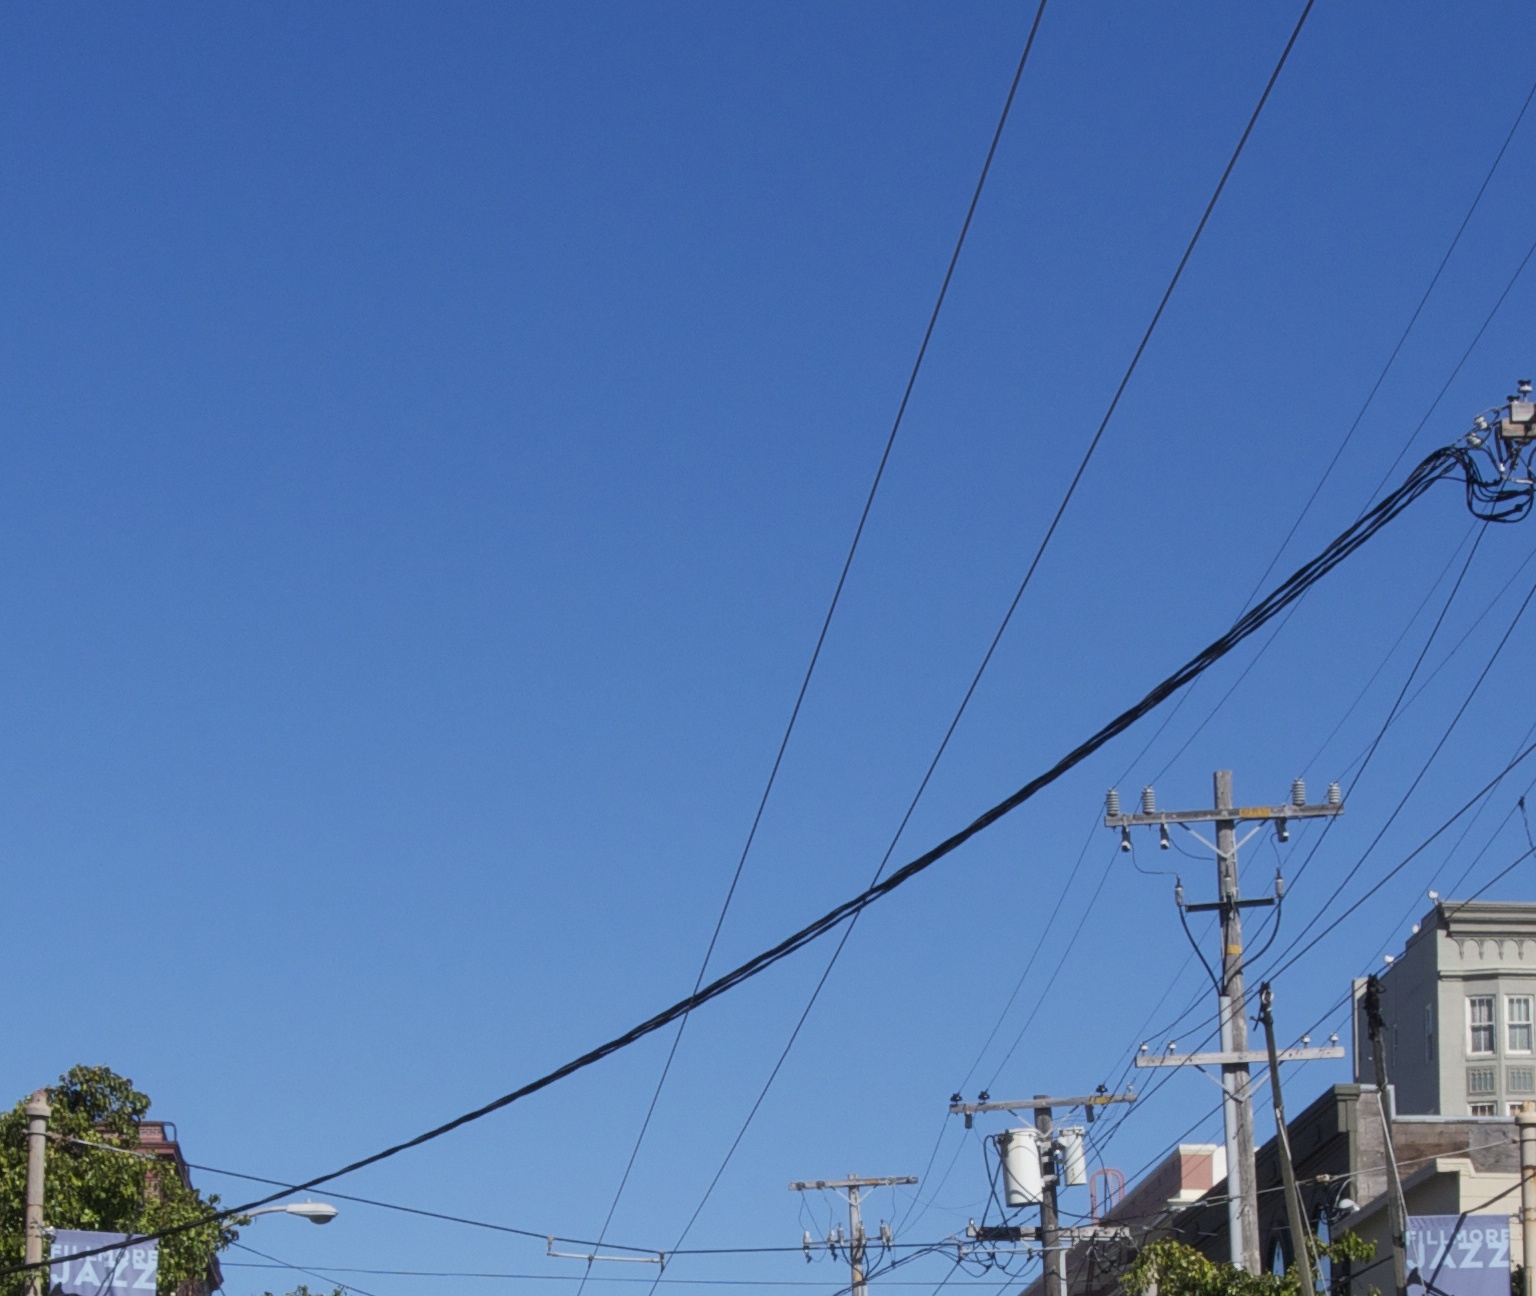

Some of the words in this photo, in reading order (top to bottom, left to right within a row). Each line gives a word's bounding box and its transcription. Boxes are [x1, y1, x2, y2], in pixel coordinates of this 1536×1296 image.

[1405, 1228, 1510, 1246] FILLMORE
[1405, 1240, 1510, 1269] JAZZ
[50, 1261, 158, 1290] JAZZ
